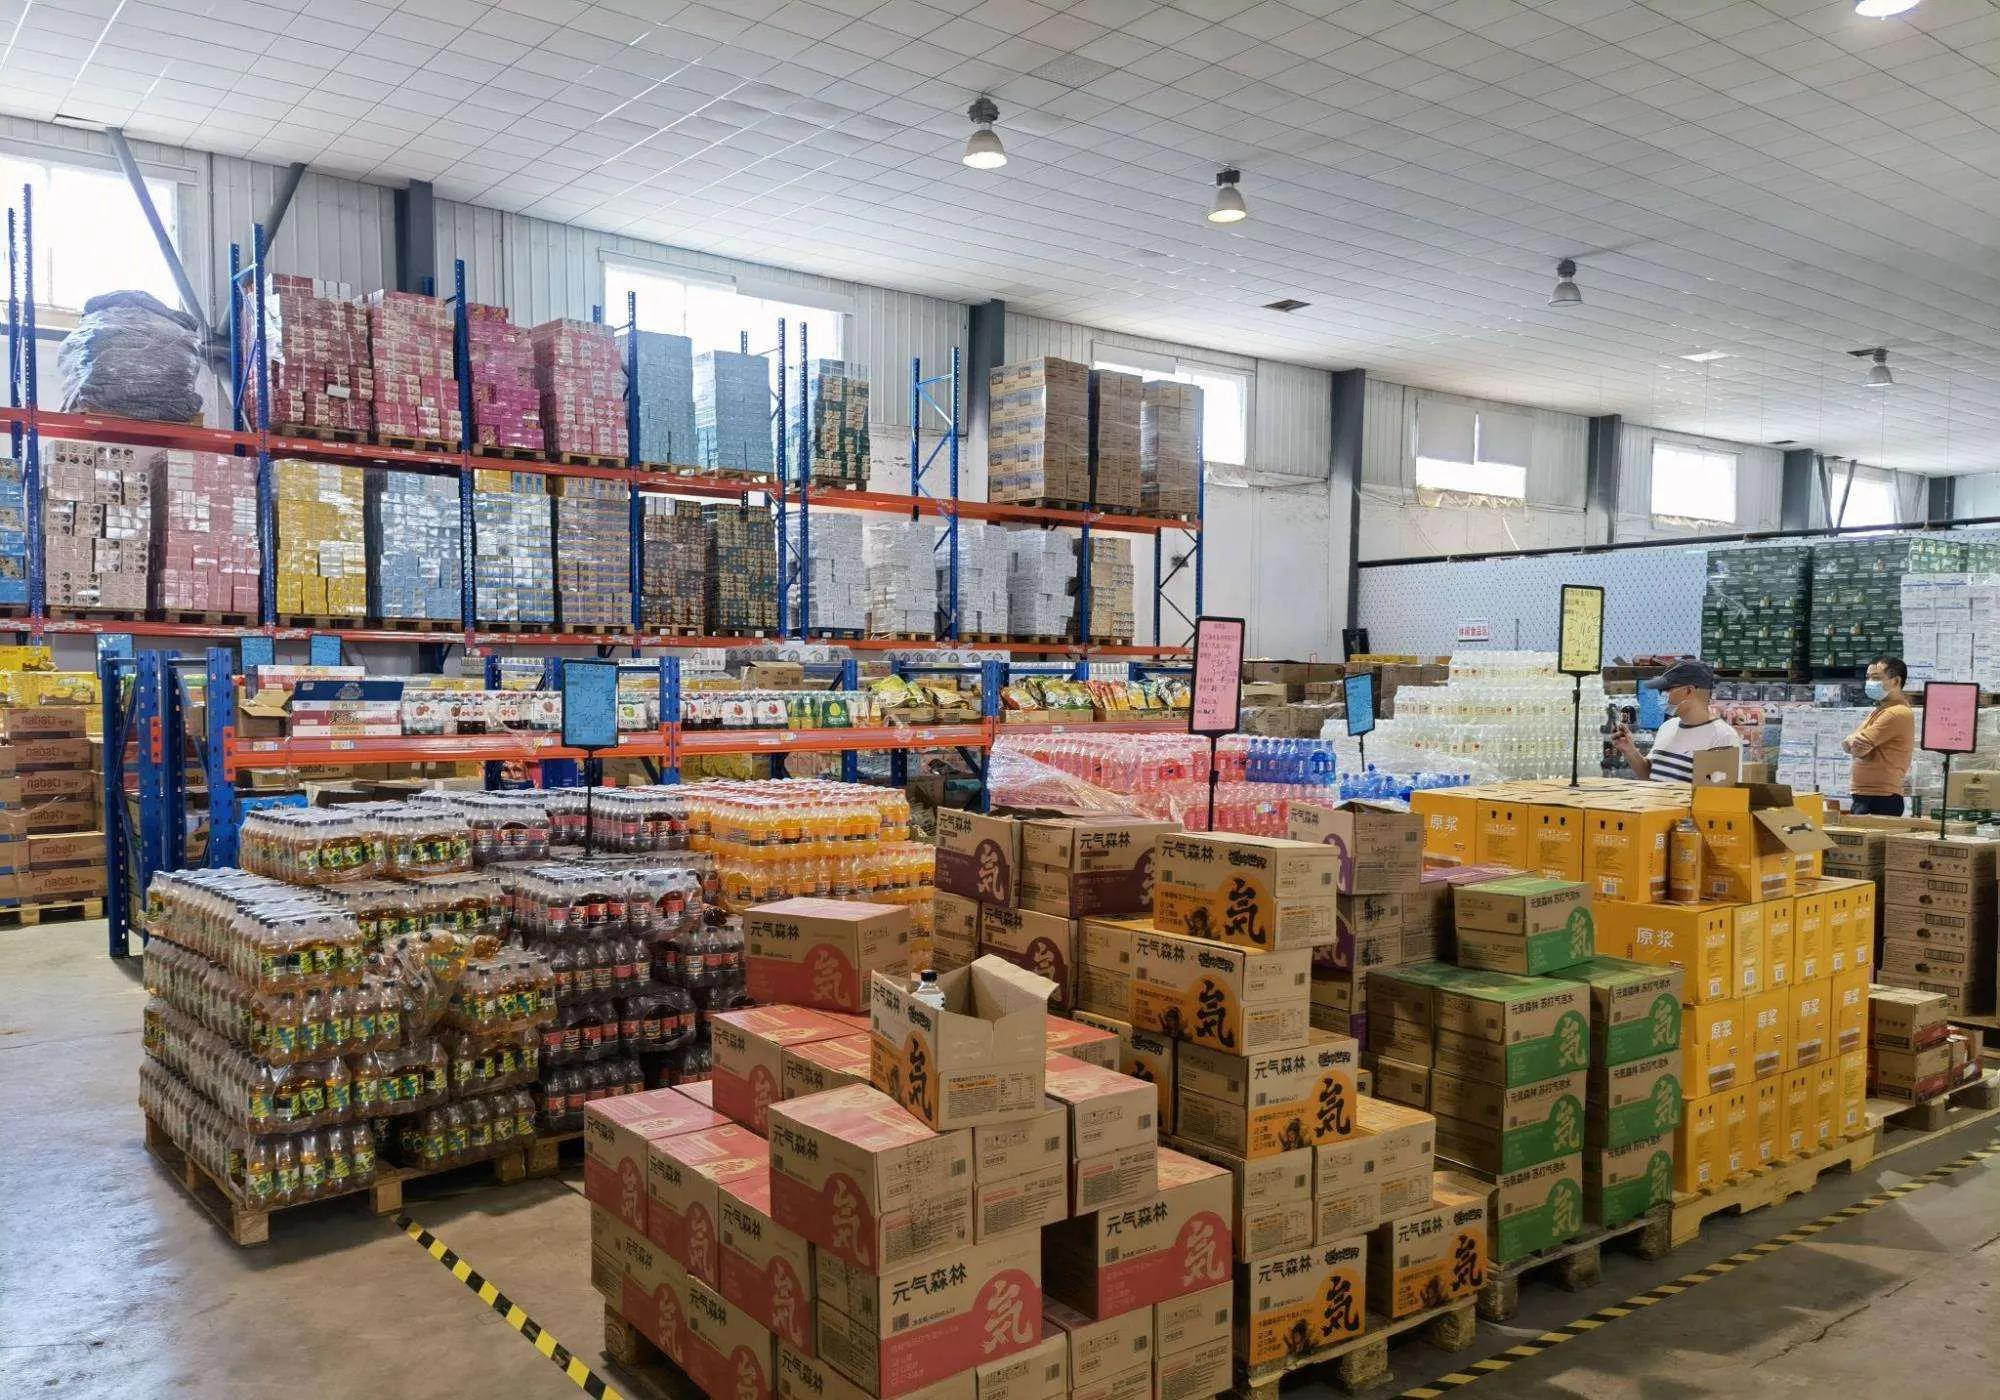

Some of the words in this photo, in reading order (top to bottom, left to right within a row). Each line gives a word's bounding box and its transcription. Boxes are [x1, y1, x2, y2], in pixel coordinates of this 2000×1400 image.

[27, 778, 60, 789] nabati
[940, 813, 973, 834] 元气森林
[1291, 808, 1319, 826] 元气森林
[1431, 815, 1458, 832] 原浆
[1080, 831, 1131, 850] 元气森林
[1161, 840, 1214, 863] 元气森林
[751, 922, 800, 941] 元气森林
[983, 907, 1023, 931] 元气森林
[1637, 927, 1674, 948] 原浆
[1137, 938, 1186, 963] 元气森林
[1711, 1020, 1732, 1040] 原浆
[1758, 1008, 1778, 1029] 原浆
[713, 1027, 746, 1054] 元气森林
[785, 1060, 824, 1090] 元气森林
[1255, 1056, 1305, 1080] 元气森林
[587, 1116, 616, 1144] 元气森林
[773, 1124, 819, 1162] 元气森林
[650, 1156, 681, 1187] 元气森林
[723, 1203, 762, 1241] 元气森林
[1106, 1201, 1168, 1237] 元气森林
[1398, 1216, 1444, 1244] 元气森林
[1258, 1254, 1312, 1284] 元气森林
[892, 1262, 967, 1306] 元气森林
[689, 1288, 728, 1325] 元气森林
[781, 1351, 824, 1396] 元气森林
